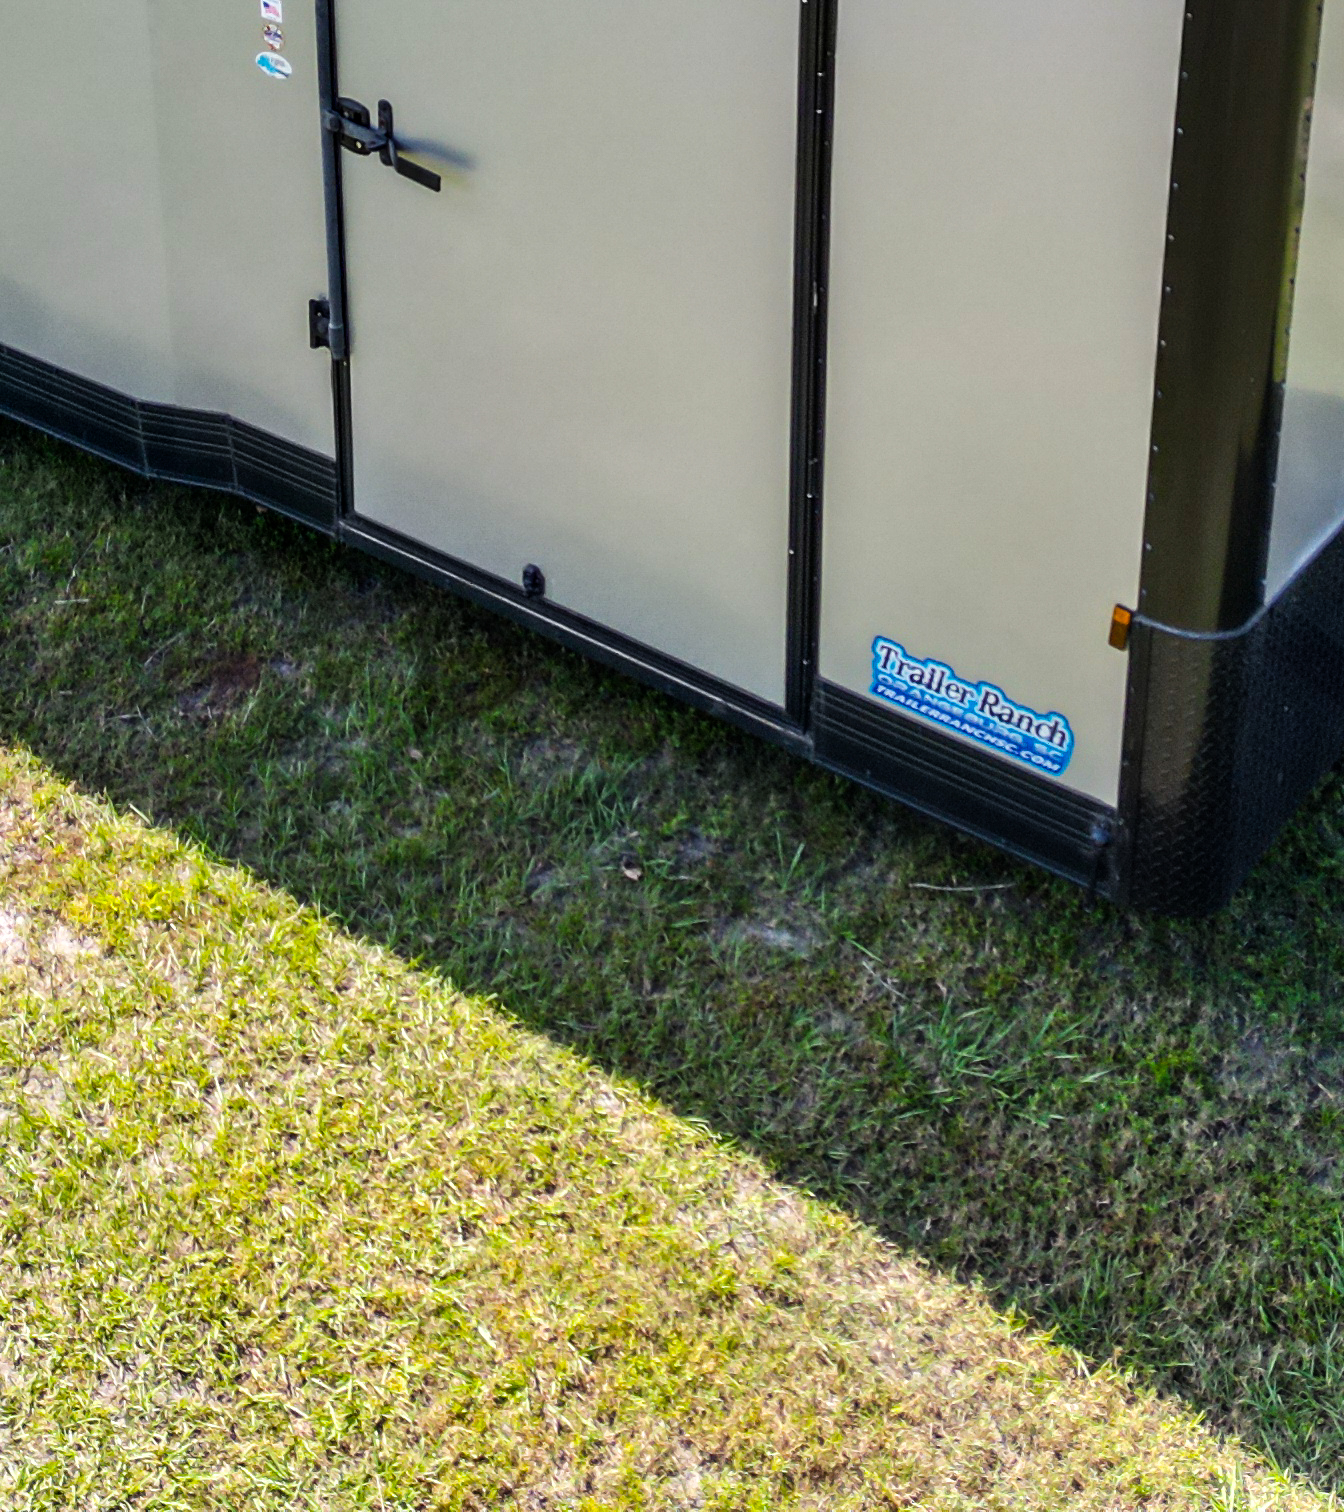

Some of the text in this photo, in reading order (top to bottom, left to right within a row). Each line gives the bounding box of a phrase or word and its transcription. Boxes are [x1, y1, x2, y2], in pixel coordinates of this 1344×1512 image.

[876, 684, 1061, 772] TRAILERRANCHSC.COM
[878, 644, 1067, 749] Trailer Ranch
